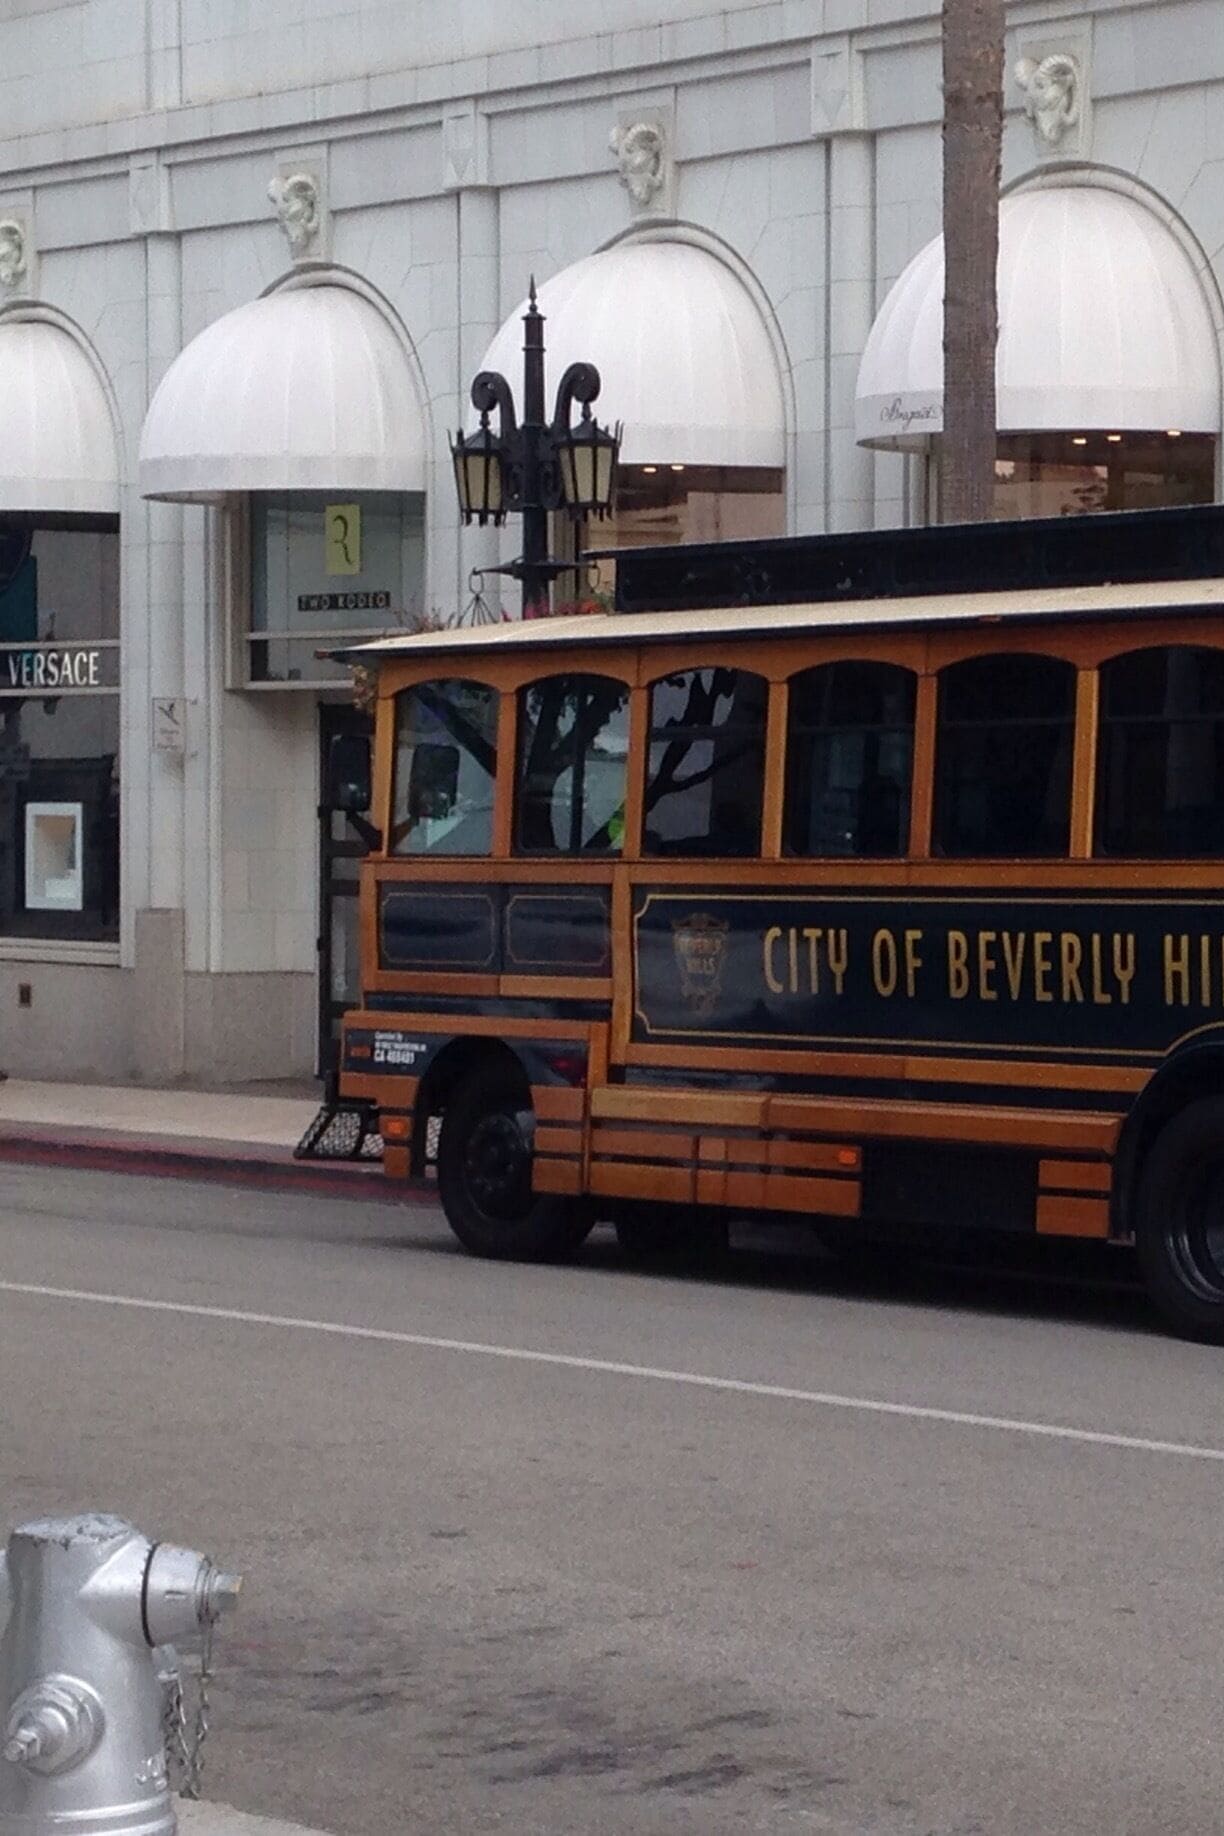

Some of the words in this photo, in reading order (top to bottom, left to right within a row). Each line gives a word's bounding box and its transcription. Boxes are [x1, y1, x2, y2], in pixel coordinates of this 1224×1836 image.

[8, 651, 100, 686] VERSACE
[764, 927, 847, 994] CITY
[873, 928, 923, 998] OF
[948, 930, 1136, 1005] BEVERLY
